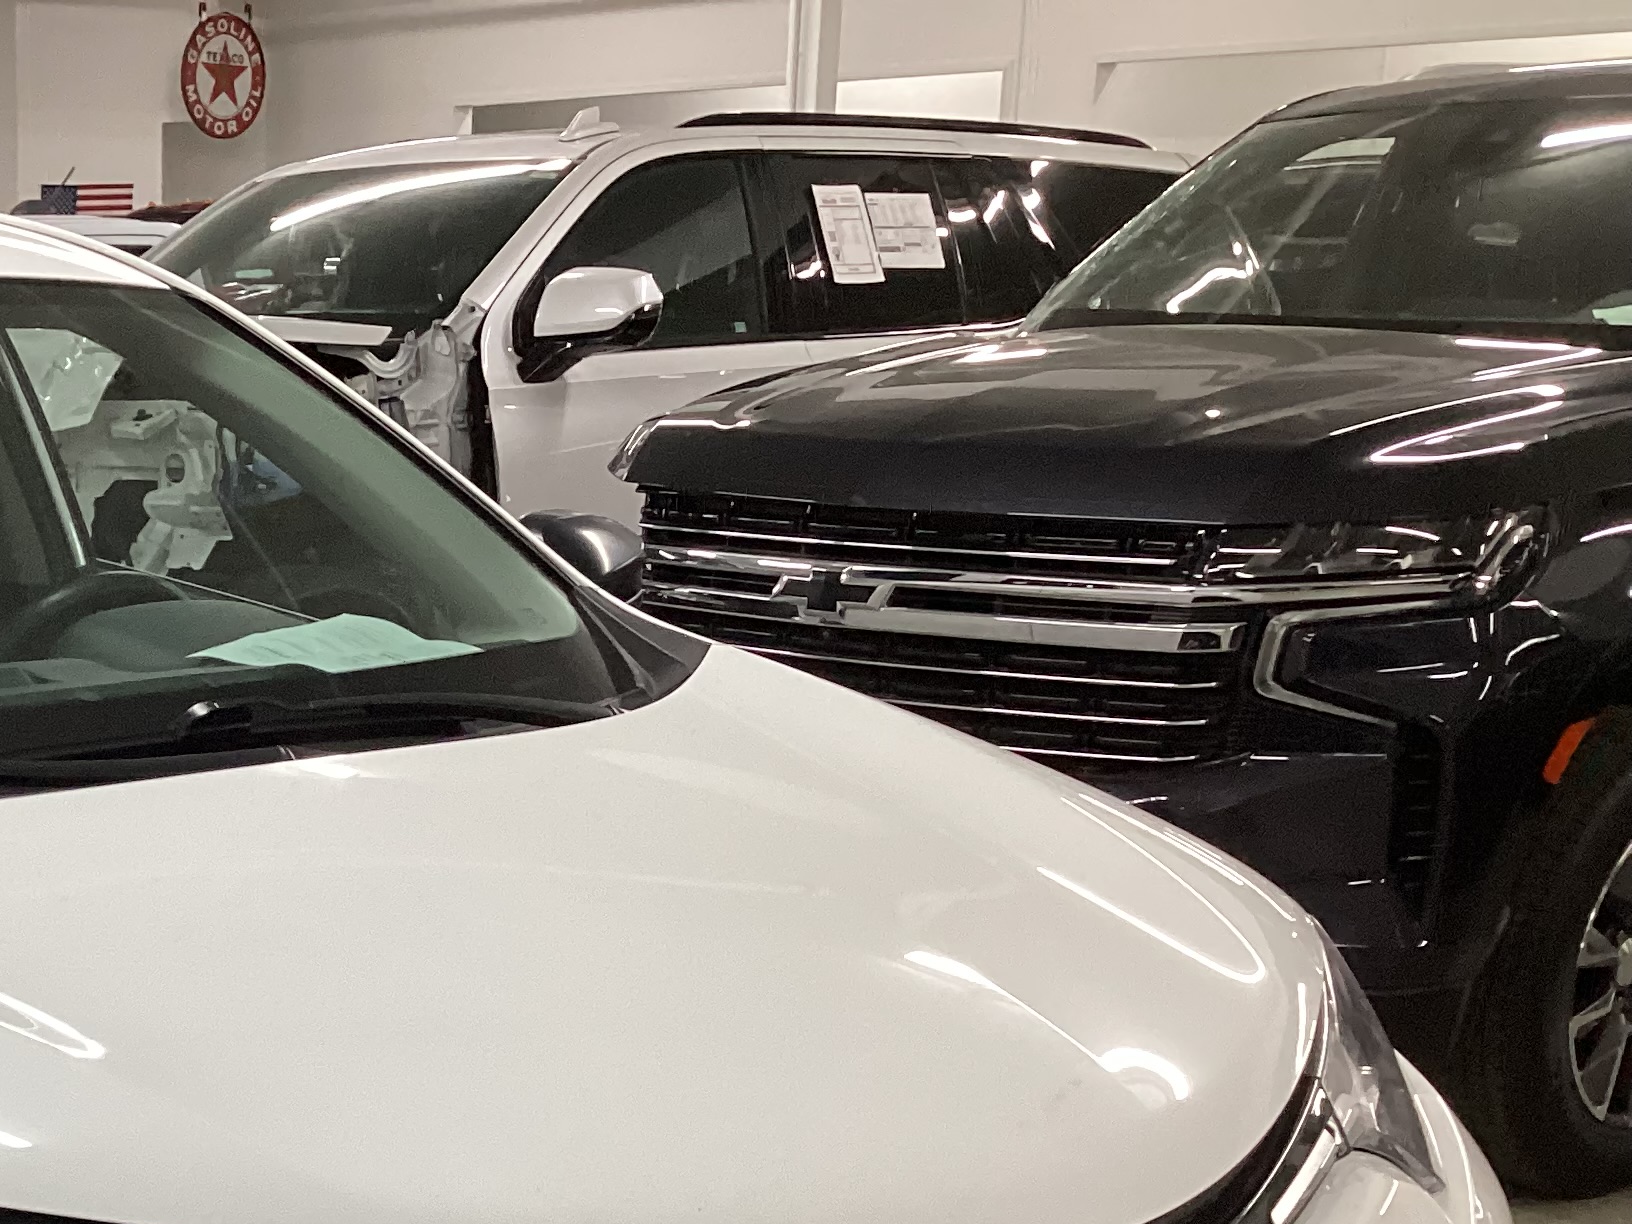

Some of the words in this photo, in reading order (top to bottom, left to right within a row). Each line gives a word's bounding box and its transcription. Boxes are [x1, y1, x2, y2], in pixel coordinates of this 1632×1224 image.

[188, 18, 261, 66] GASOLINE
[206, 51, 244, 64] TECO
[186, 84, 238, 135] MOTOR
[242, 86, 262, 121] OIL
